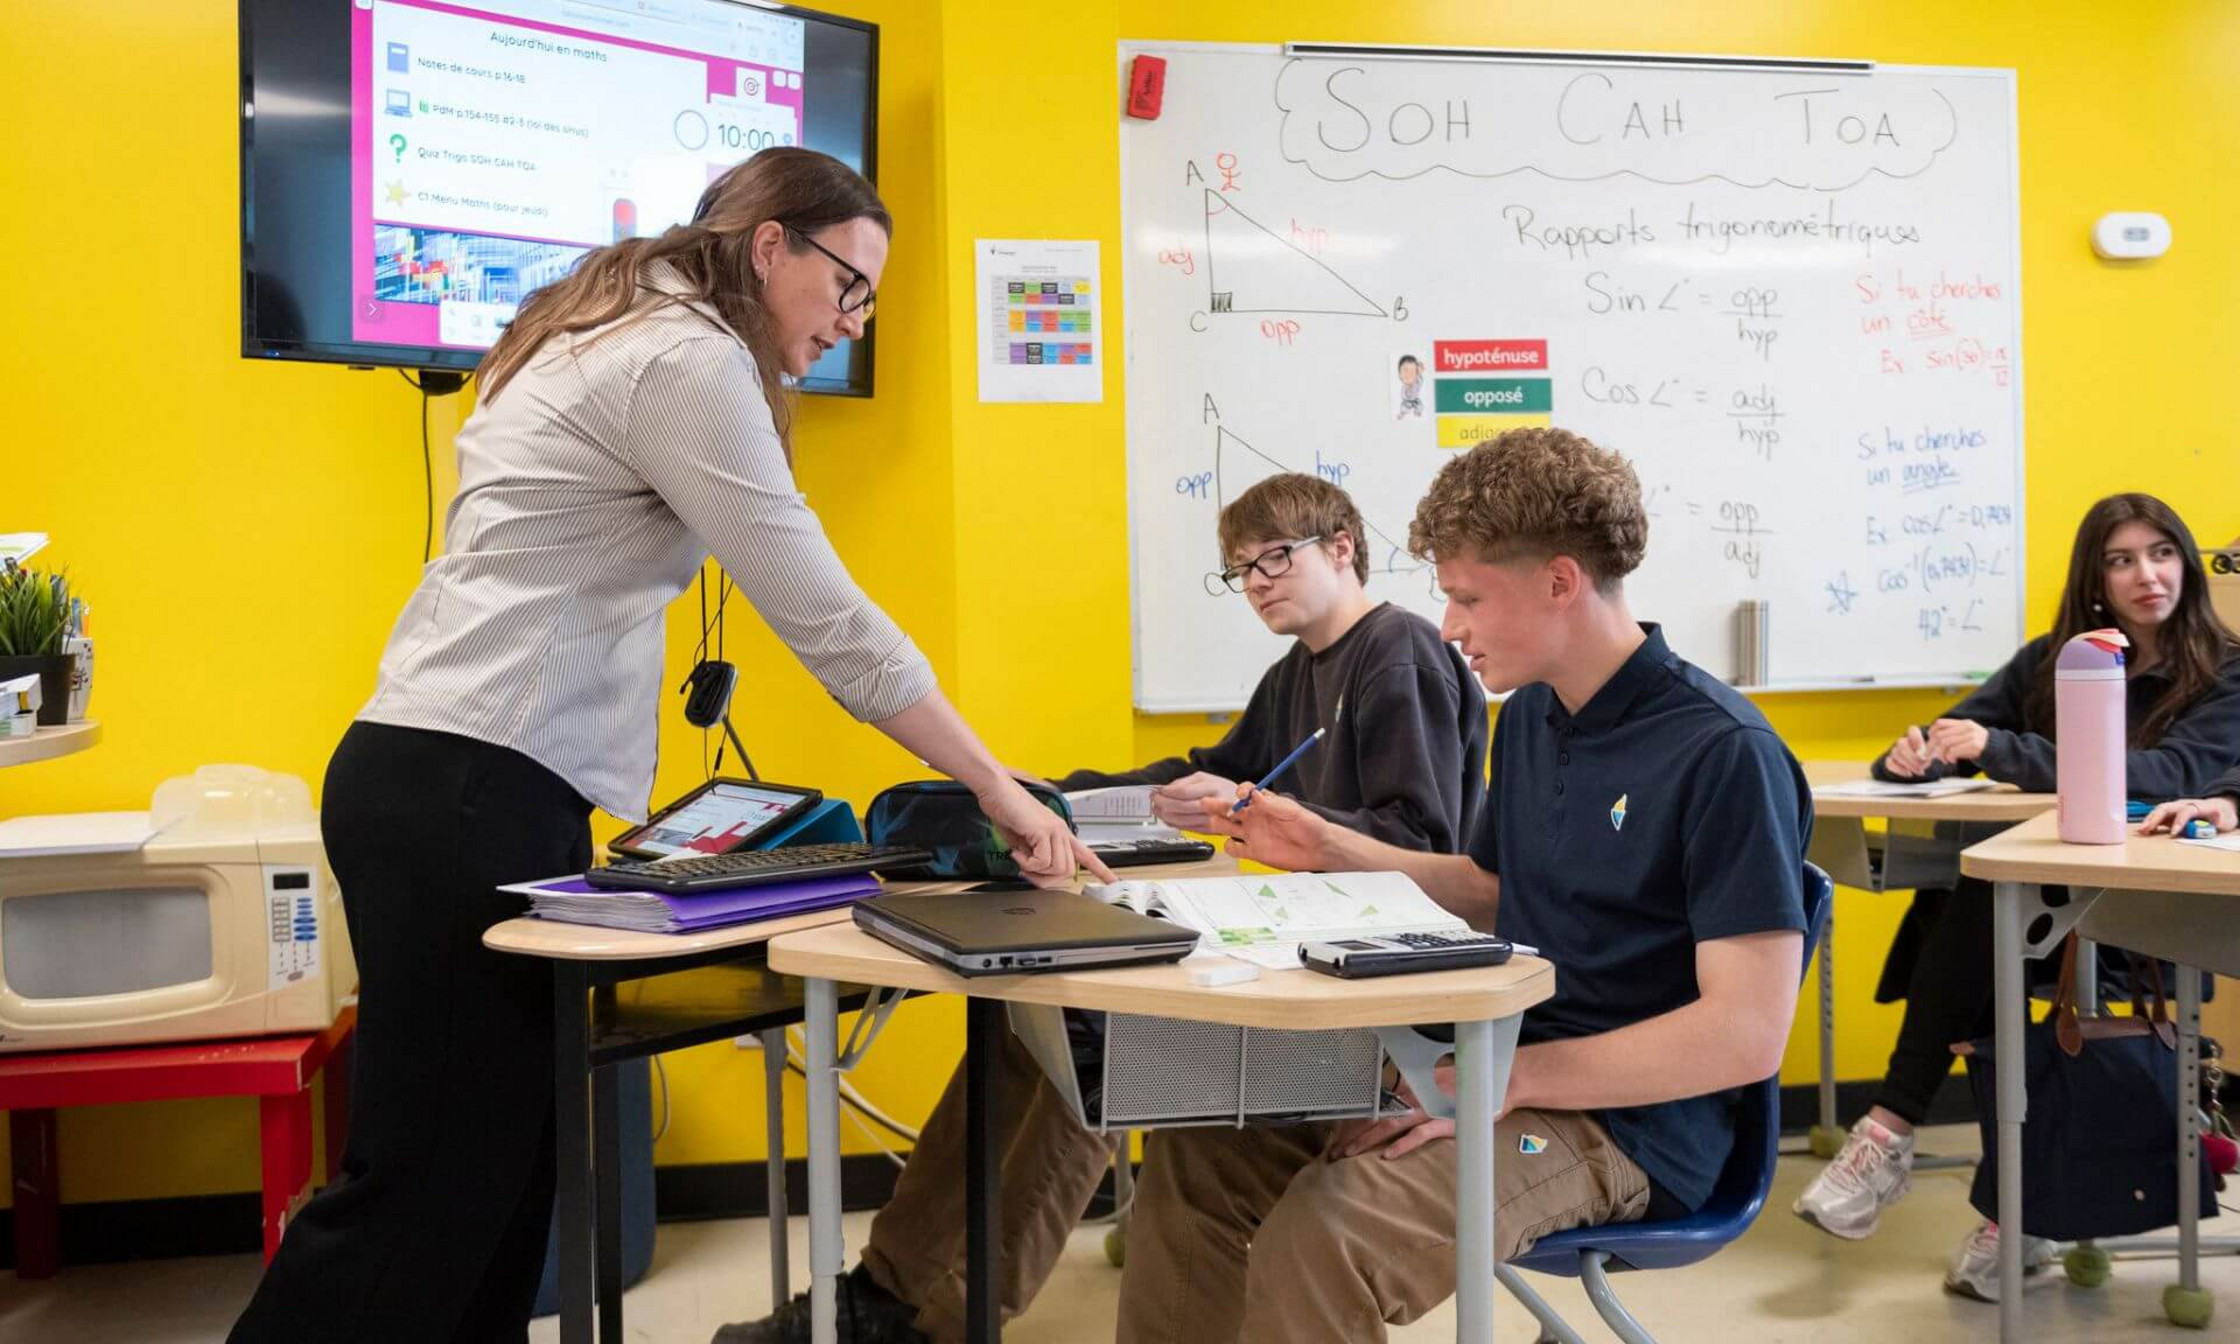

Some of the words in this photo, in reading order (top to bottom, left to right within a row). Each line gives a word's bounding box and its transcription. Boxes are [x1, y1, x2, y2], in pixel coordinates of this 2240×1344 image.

[490, 32, 554, 52] Aujourd'hui
[557, 45, 571, 55] en
[573, 48, 608, 62] maths
[418, 57, 447, 71] Notes
[450, 63, 463, 73] de
[466, 68, 493, 79] cours
[718, 124, 775, 151] 10:00
[418, 147, 440, 159] Quiz
[1187, 160, 1204, 187] A
[461, 197, 491, 210] Maths
[1502, 204, 1656, 260] Rapports
[1393, 296, 1410, 322] B
[1731, 286, 1778, 317] opp
[1190, 310, 1208, 332] C
[1861, 315, 1891, 335] un
[1738, 317, 1779, 361] hyp
[1444, 348, 1539, 369] hypoténuse
[1204, 392, 1220, 424] A
[1464, 386, 1524, 407] opposé
[1738, 421, 1781, 462] hyp
[1176, 471, 1212, 500] opp
[1867, 467, 1891, 486] un
[1720, 501, 1760, 537] opp
